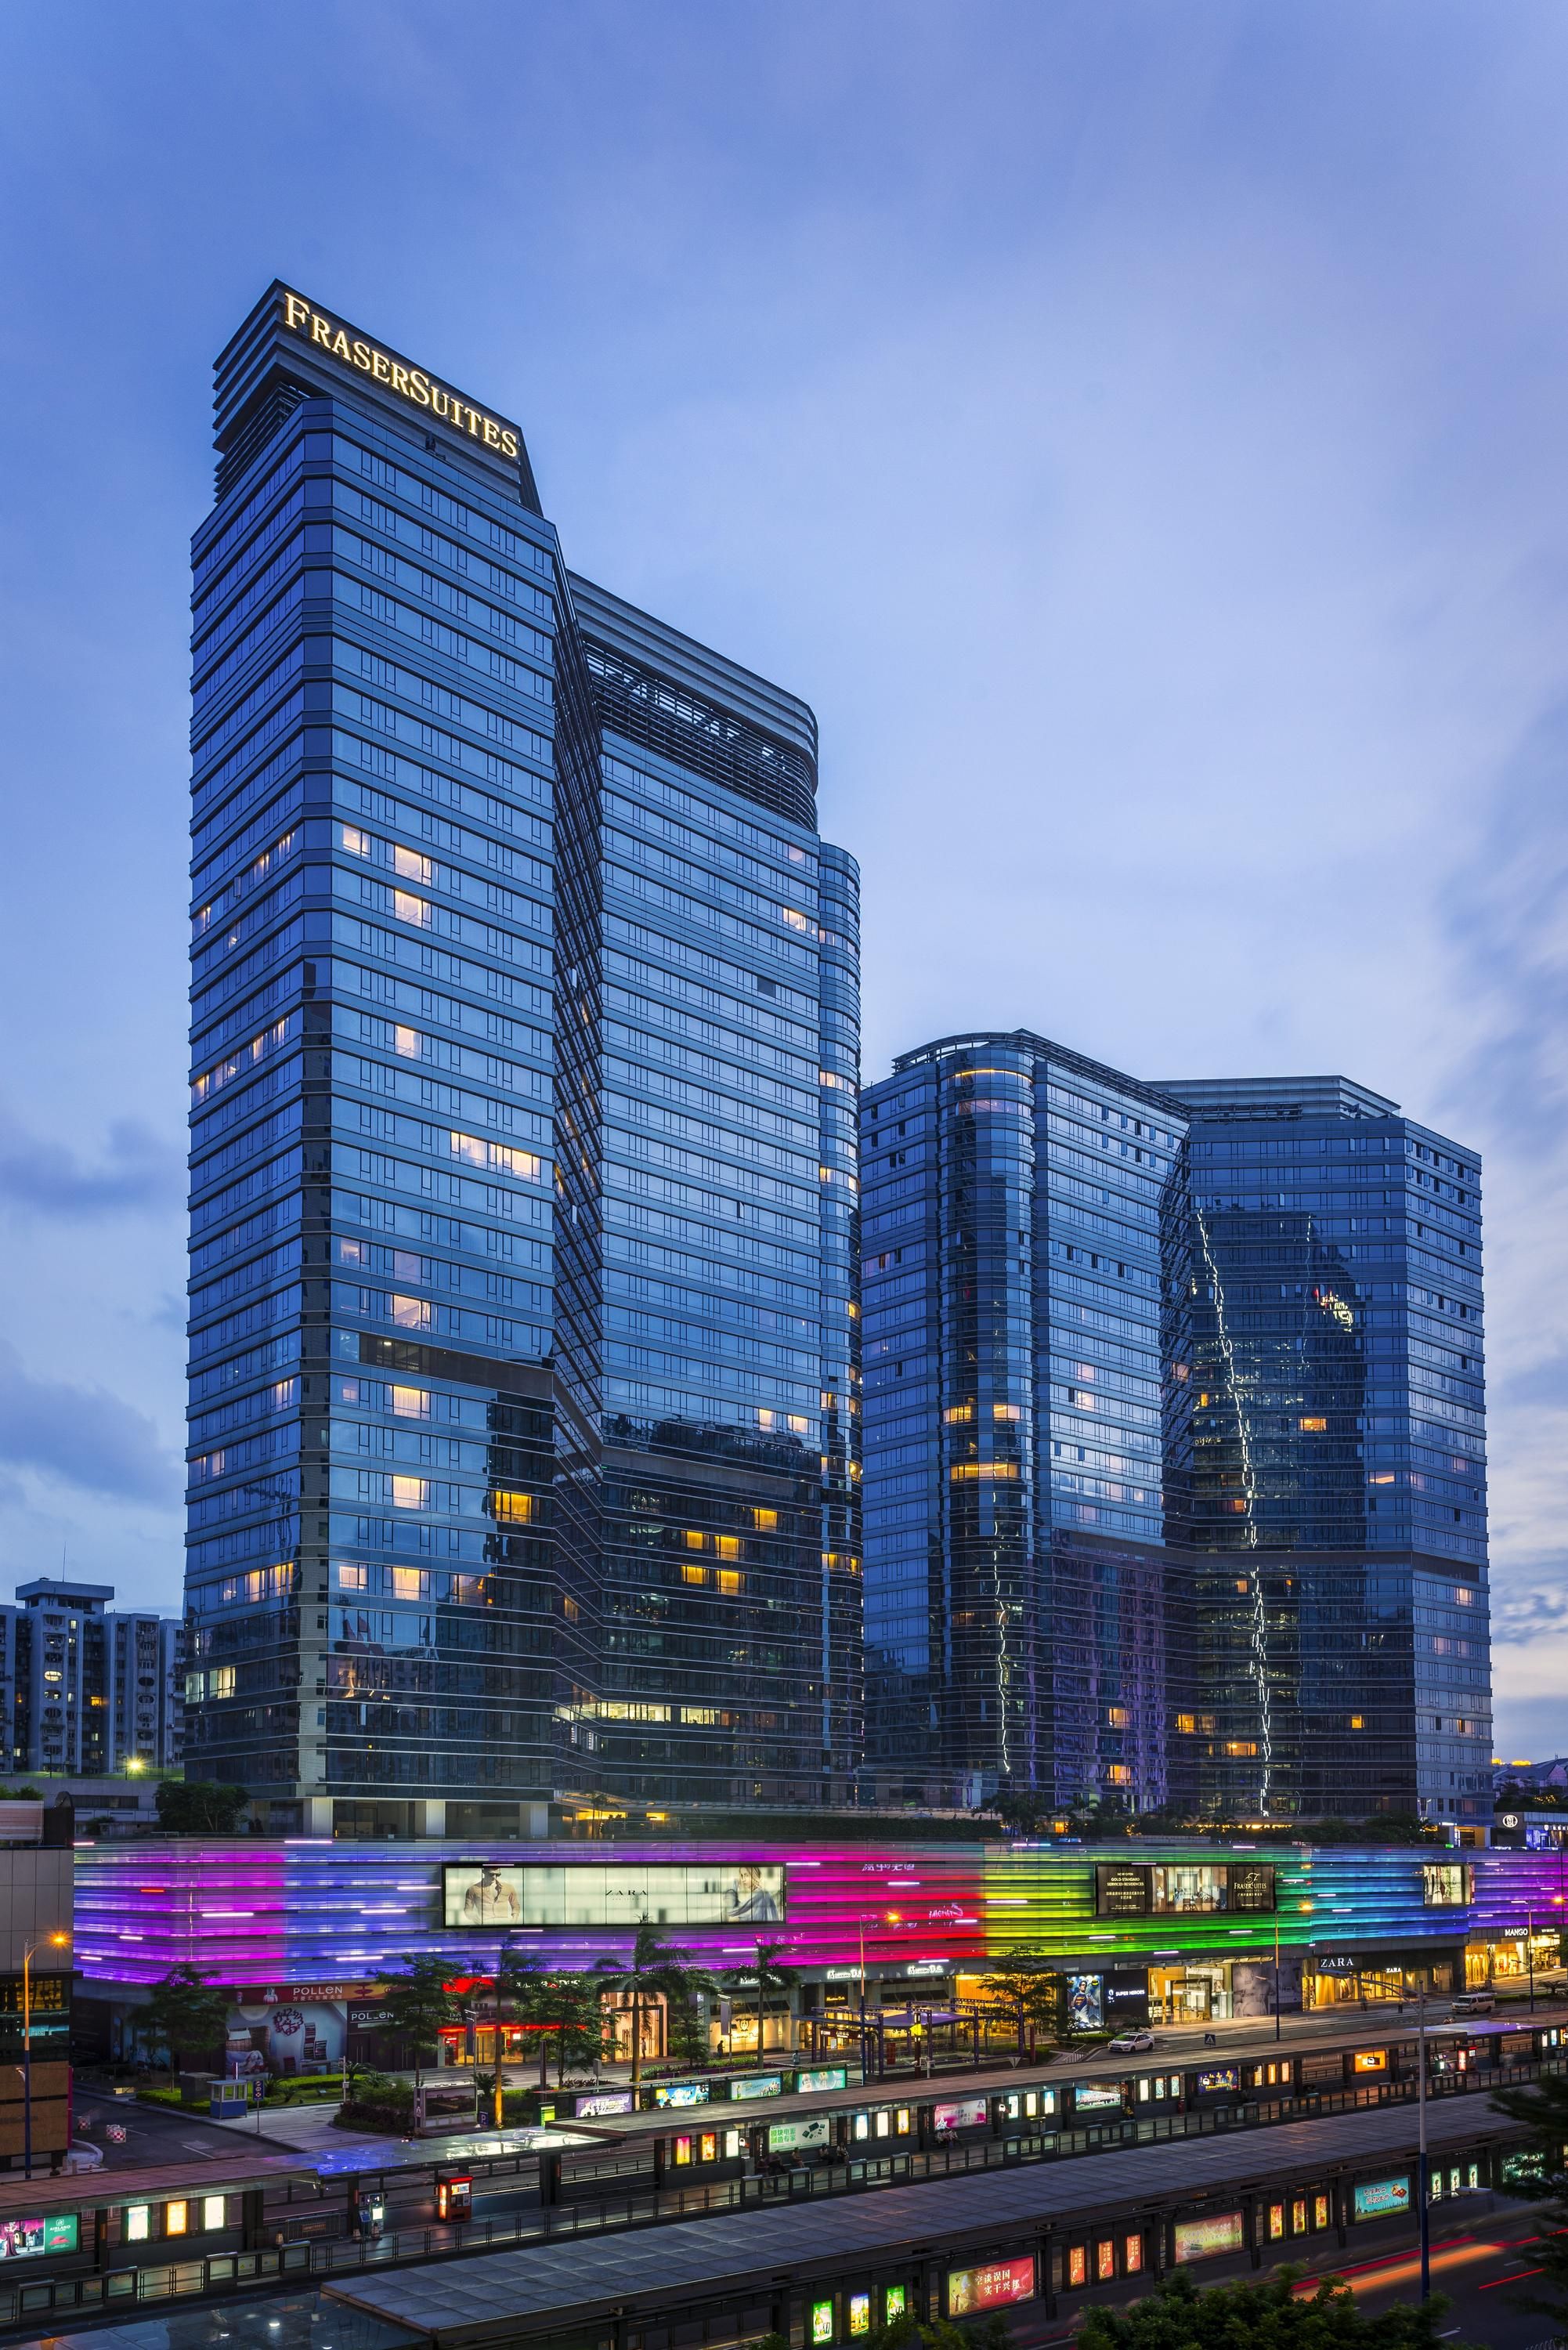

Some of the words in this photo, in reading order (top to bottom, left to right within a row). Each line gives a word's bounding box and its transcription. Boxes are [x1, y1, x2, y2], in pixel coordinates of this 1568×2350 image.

[285, 292, 518, 457] FRASERSUITES
[1505, 1928, 1528, 1936] MANGO
[1321, 1958, 1353, 1968] ZARA
[1114, 2085, 1126, 2094] S2
[974, 2269, 1010, 2286] 空谈误国
[984, 2279, 1020, 2297] 实干兴邦
